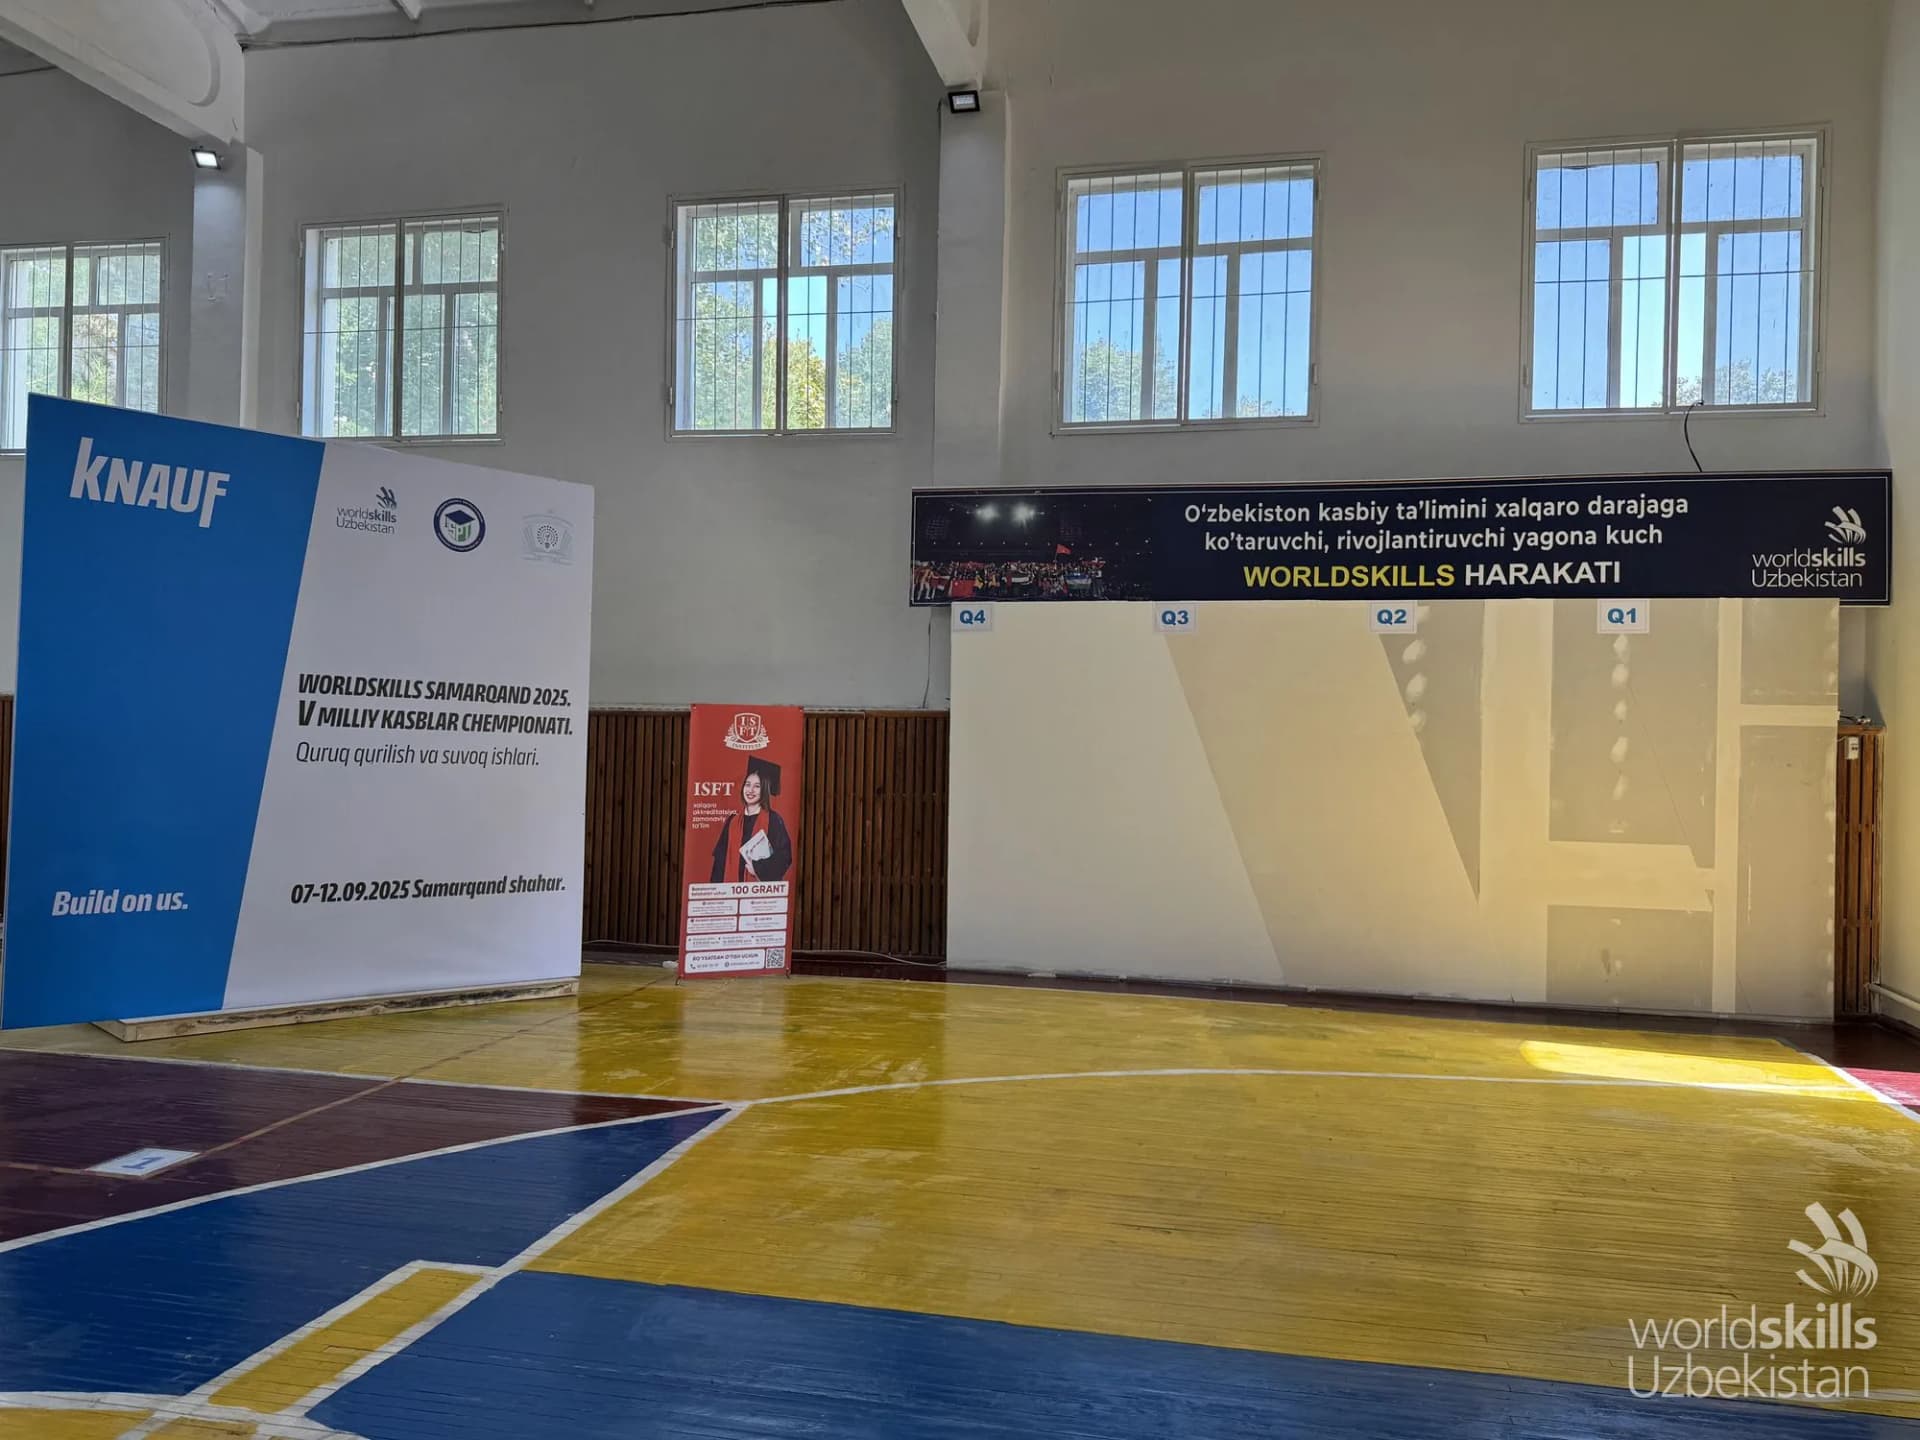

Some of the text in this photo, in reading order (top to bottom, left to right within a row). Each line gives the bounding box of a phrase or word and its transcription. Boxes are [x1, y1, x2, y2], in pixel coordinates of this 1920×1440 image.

[336, 507, 397, 523] worldskills
[1318, 500, 1389, 525] kasbiy
[1494, 496, 1580, 521] xalqaro
[1587, 493, 1689, 519] darajaga
[336, 516, 395, 535] Uzbekistan
[1337, 526, 1506, 554] rivojlantiruvchi
[1513, 528, 1597, 552] yagona
[1606, 524, 1663, 545] kuch
[1751, 547, 1867, 568] worldskills
[1243, 560, 1621, 588] WORLDSKILLS HARAKATI
[1751, 567, 1863, 588] Uzbekistan
[959, 609, 986, 625] Q4
[1161, 610, 1189, 626] Q3
[1376, 608, 1408, 627] Q2
[1607, 607, 1637, 625] Q1
[298, 673, 571, 707] WORLDSKILLS SAMARQAND 2025.
[298, 699, 573, 735] V MILLIY KASBLAR CHEMPIONATI.
[296, 741, 540, 769] Quruq qurilish va suvoq ishlari.
[694, 782, 735, 797] ISFT
[291, 874, 567, 904] 07-12.09.2025 Samarqand shahar.
[731, 885, 749, 895] 100
[751, 884, 786, 894] GRANT
[51, 889, 189, 916] Build on us.
